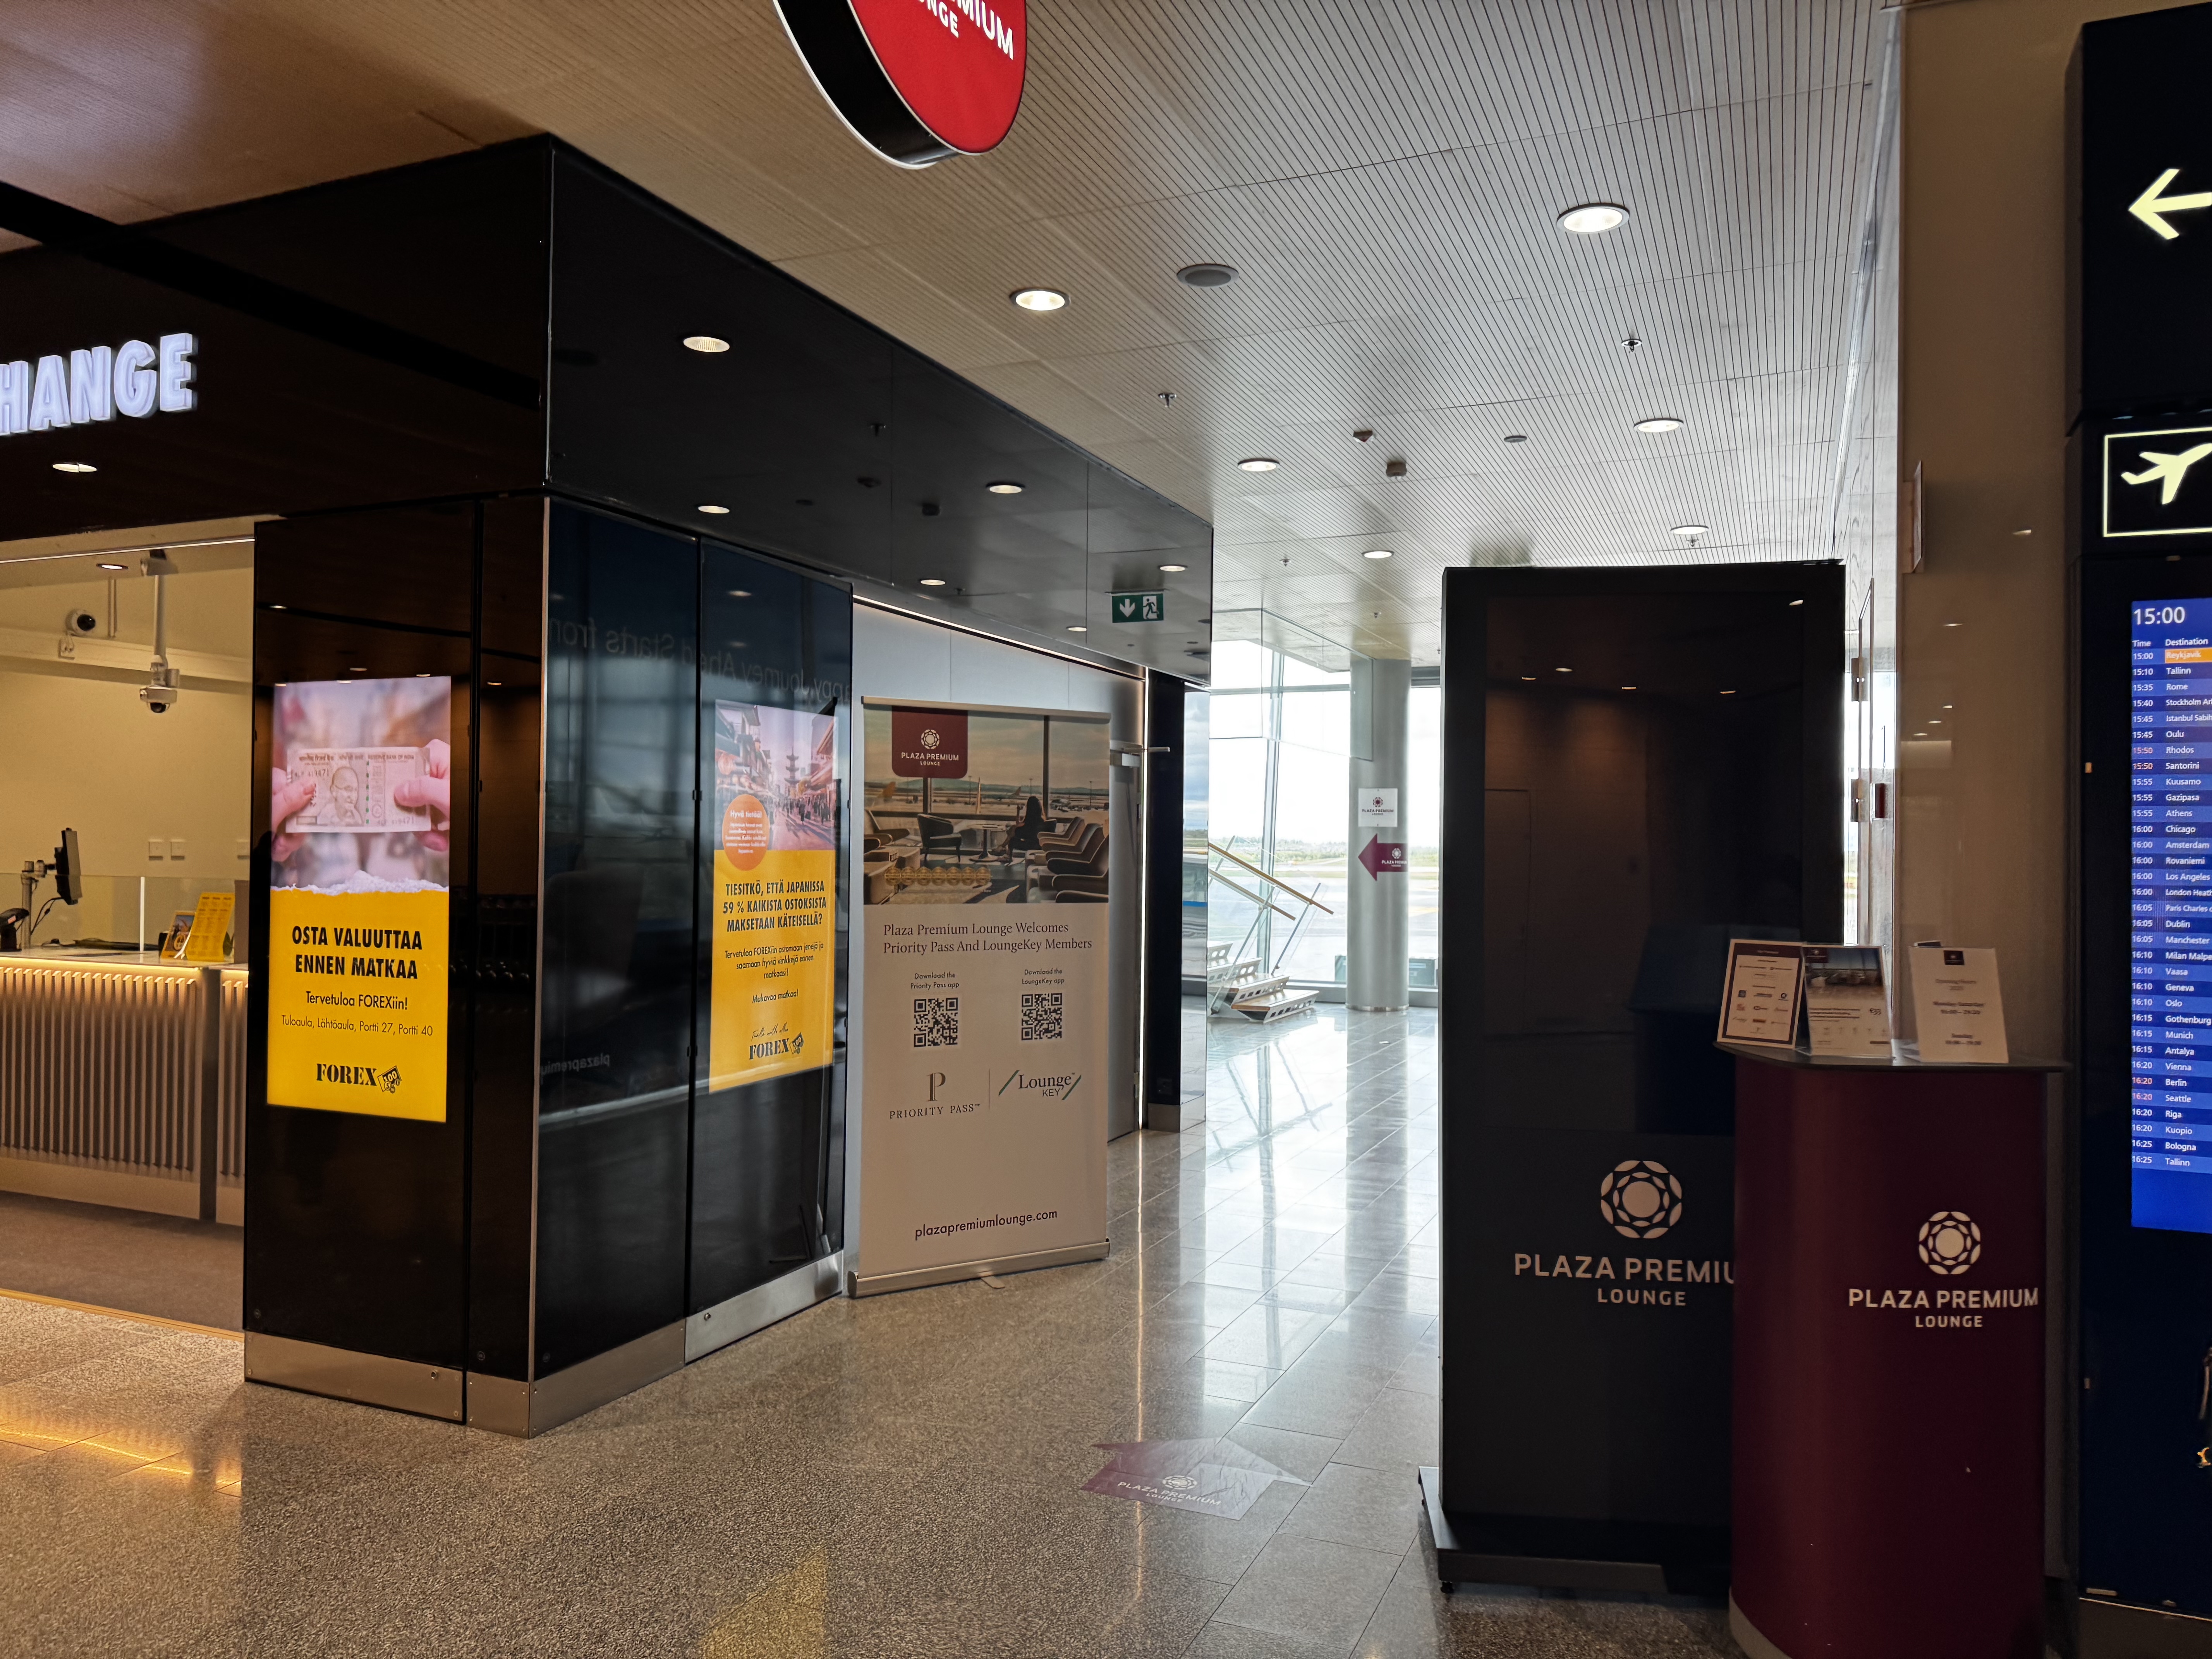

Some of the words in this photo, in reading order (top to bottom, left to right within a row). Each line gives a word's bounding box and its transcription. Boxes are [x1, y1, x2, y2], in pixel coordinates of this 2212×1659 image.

[2134, 606, 2185, 625] 15:00
[2165, 637, 2209, 646] Destination
[2166, 651, 2201, 660] Reykjavik
[2166, 825, 2196, 834] Chicago
[2180, 873, 2210, 882] Angeles
[726, 880, 763, 896] TIESITKÖ,
[767, 879, 784, 894] ETTÄ
[787, 881, 824, 893] JAPANISSA
[723, 902, 733, 914] 59
[737, 901, 744, 913] %
[747, 899, 782, 912] KAIKISTA
[785, 897, 826, 910] OSTOKSISTA
[727, 917, 775, 932] MAKSETAAN
[778, 911, 823, 928] KÄTEISELLÄ?
[884, 924, 913, 936] Plaza
[918, 923, 968, 935] Premium
[972, 923, 1012, 936] Lounge
[1015, 921, 1068, 933] Welcomes
[292, 926, 328, 945] OSTA
[334, 927, 422, 950] VALUUTTAA
[725, 948, 752, 959] Tervetuloa
[754, 946, 777, 956] FOREXiin
[778, 945, 802, 953] ostamaan
[884, 941, 927, 956] Priority
[931, 941, 954, 952] Pass
[957, 940, 979, 951] And
[984, 939, 1042, 953] LoungeKey
[1045, 938, 1092, 950] Members
[295, 954, 345, 975] ENNEN
[351, 957, 418, 979] MATKAA
[736, 960, 761, 970] saamaan
[762, 957, 776, 969] hyviä
[778, 955, 798, 965] vinkkejä
[764, 968, 789, 979] matkaasi!
[914, 971, 945, 979] Download
[910, 982, 932, 991] Priority
[306, 990, 355, 1007] Tervetuloa
[358, 994, 408, 1010] FOREXiin!
[752, 993, 776, 1003] Mukavaa
[778, 988, 799, 999] matkaa!
[282, 1015, 314, 1029] Tuloaula,
[317, 1017, 356, 1032] Lähtöaula,
[359, 1020, 379, 1033] Portti
[381, 1022, 395, 1036] 27,
[398, 1023, 418, 1036] Portti
[421, 1025, 433, 1037] 40
[2166, 1015, 2212, 1025] Gothenburg
[2166, 1031, 2193, 1039] Munich
[749, 1038, 789, 1060] FOREX
[2165, 1047, 2195, 1056] Antalya
[2166, 1062, 2192, 1070] Vienna
[316, 1063, 378, 1087] FOREX
[2166, 1079, 2187, 1087] Berlin
[1042, 1088, 1060, 1097] KEY
[890, 1106, 944, 1119] PRIORITY
[2166, 1110, 2182, 1119] Riga
[2166, 1127, 2193, 1135] Kuopio
[2166, 1142, 2197, 1151] Bologna
[2165, 1158, 2190, 1166] Tallinn
[915, 1210, 1057, 1241] plazapremiumlounge.com
[1515, 1253, 1616, 1279] PLAZA
[1597, 1288, 1686, 1306] LOUNGE
[1848, 1288, 1930, 1309] PLAZA
[1936, 1287, 2039, 1309] PREMIUM
[1915, 1315, 1983, 1328] LOUNGE
[1117, 1481, 1158, 1494] PLAZA
[1161, 1490, 1221, 1506] PREMIUM
[1146, 1492, 1183, 1503] LOUNGE
